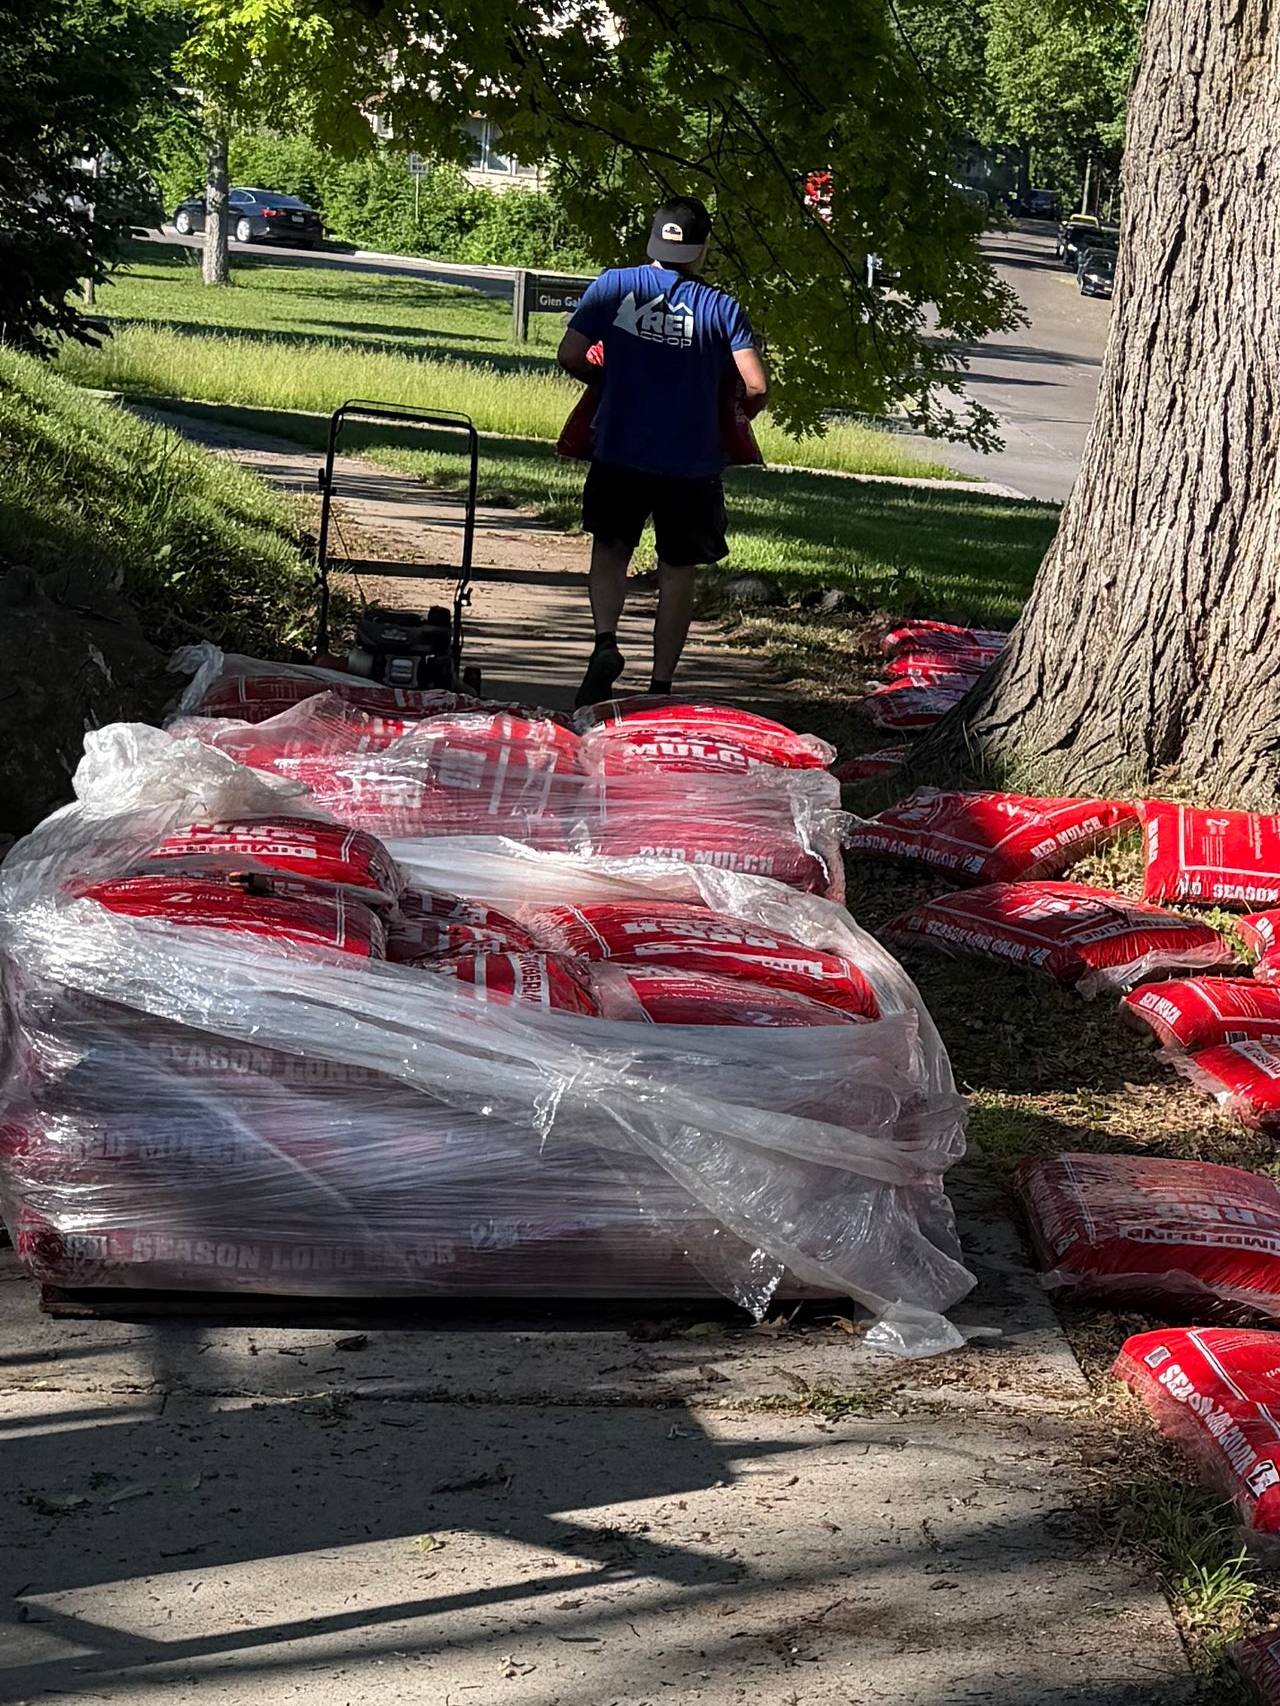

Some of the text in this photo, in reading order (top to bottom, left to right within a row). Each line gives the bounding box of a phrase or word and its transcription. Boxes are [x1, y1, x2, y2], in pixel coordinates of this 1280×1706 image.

[539, 294, 562, 307] Glen
[641, 311, 694, 338] REI
[1212, 883, 1279, 904] SEASON
